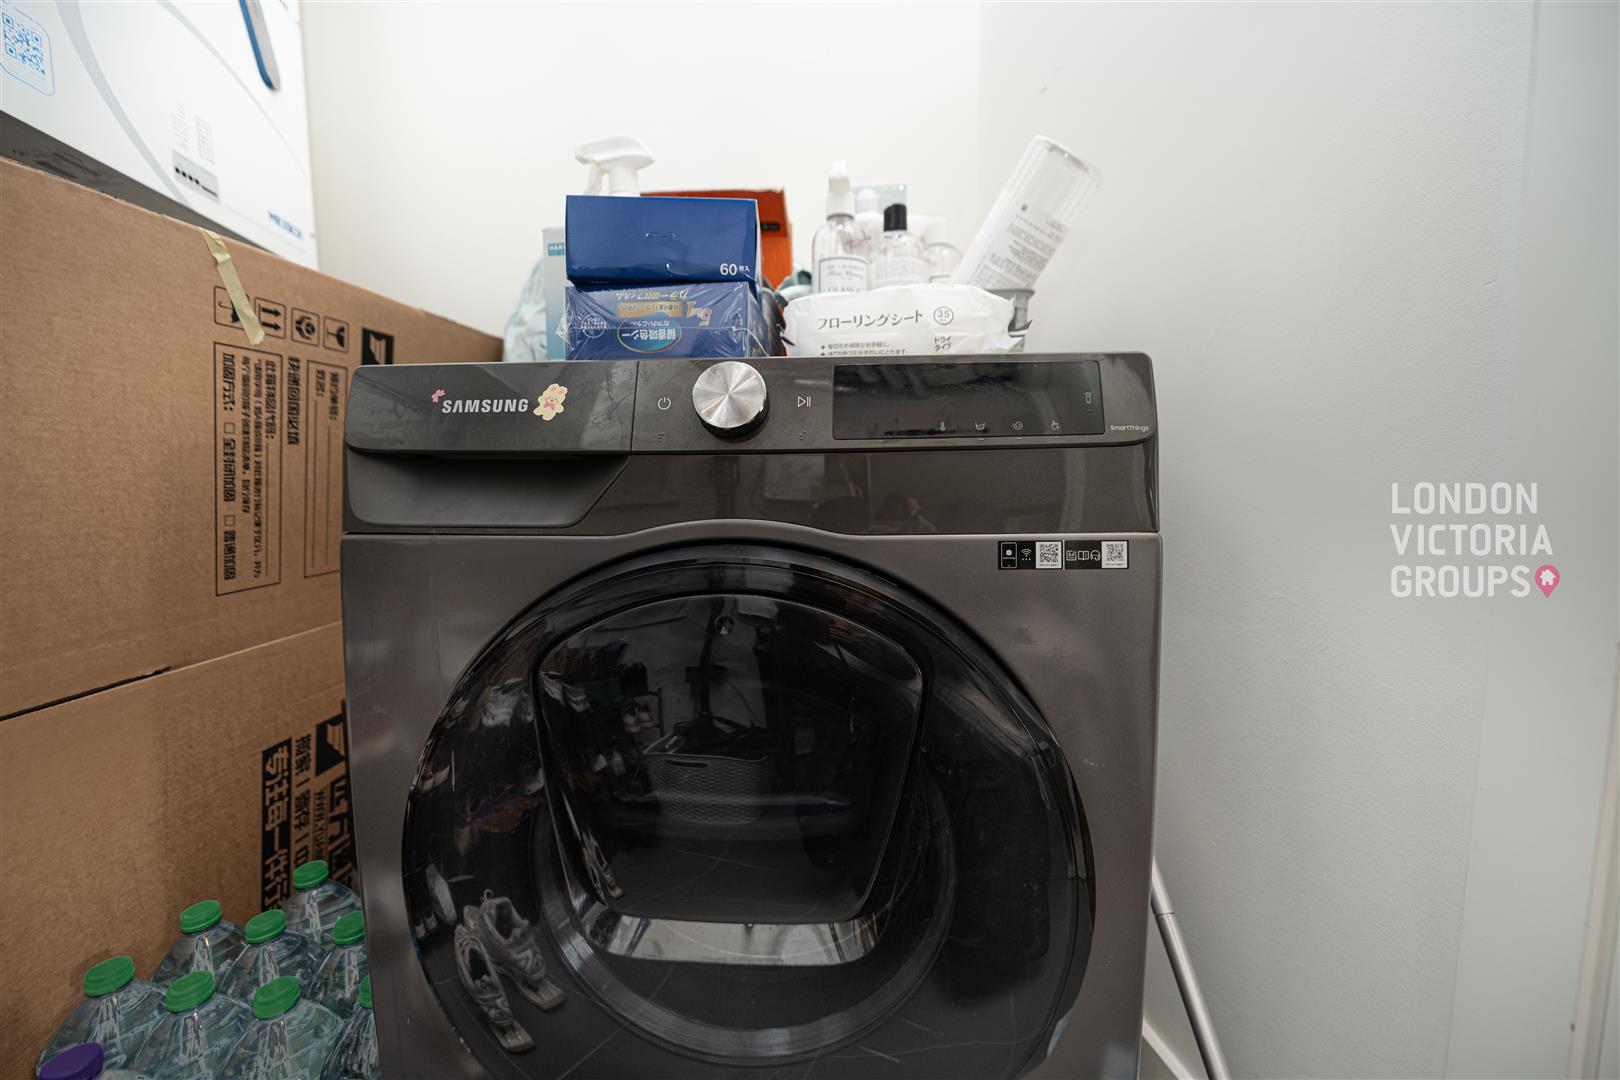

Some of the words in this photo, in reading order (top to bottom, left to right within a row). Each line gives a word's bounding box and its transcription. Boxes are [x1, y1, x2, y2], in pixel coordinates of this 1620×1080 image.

[817, 309, 923, 330] フローリングシート
[937, 309, 951, 319] 35
[934, 335, 952, 343] ドライ
[934, 343, 951, 352] タイプ
[441, 398, 529, 414] SAMSUNG
[1109, 423, 1150, 433] SmartThings
[223, 530, 236, 581] 普通加固
[264, 746, 290, 909] 专注每一件行
